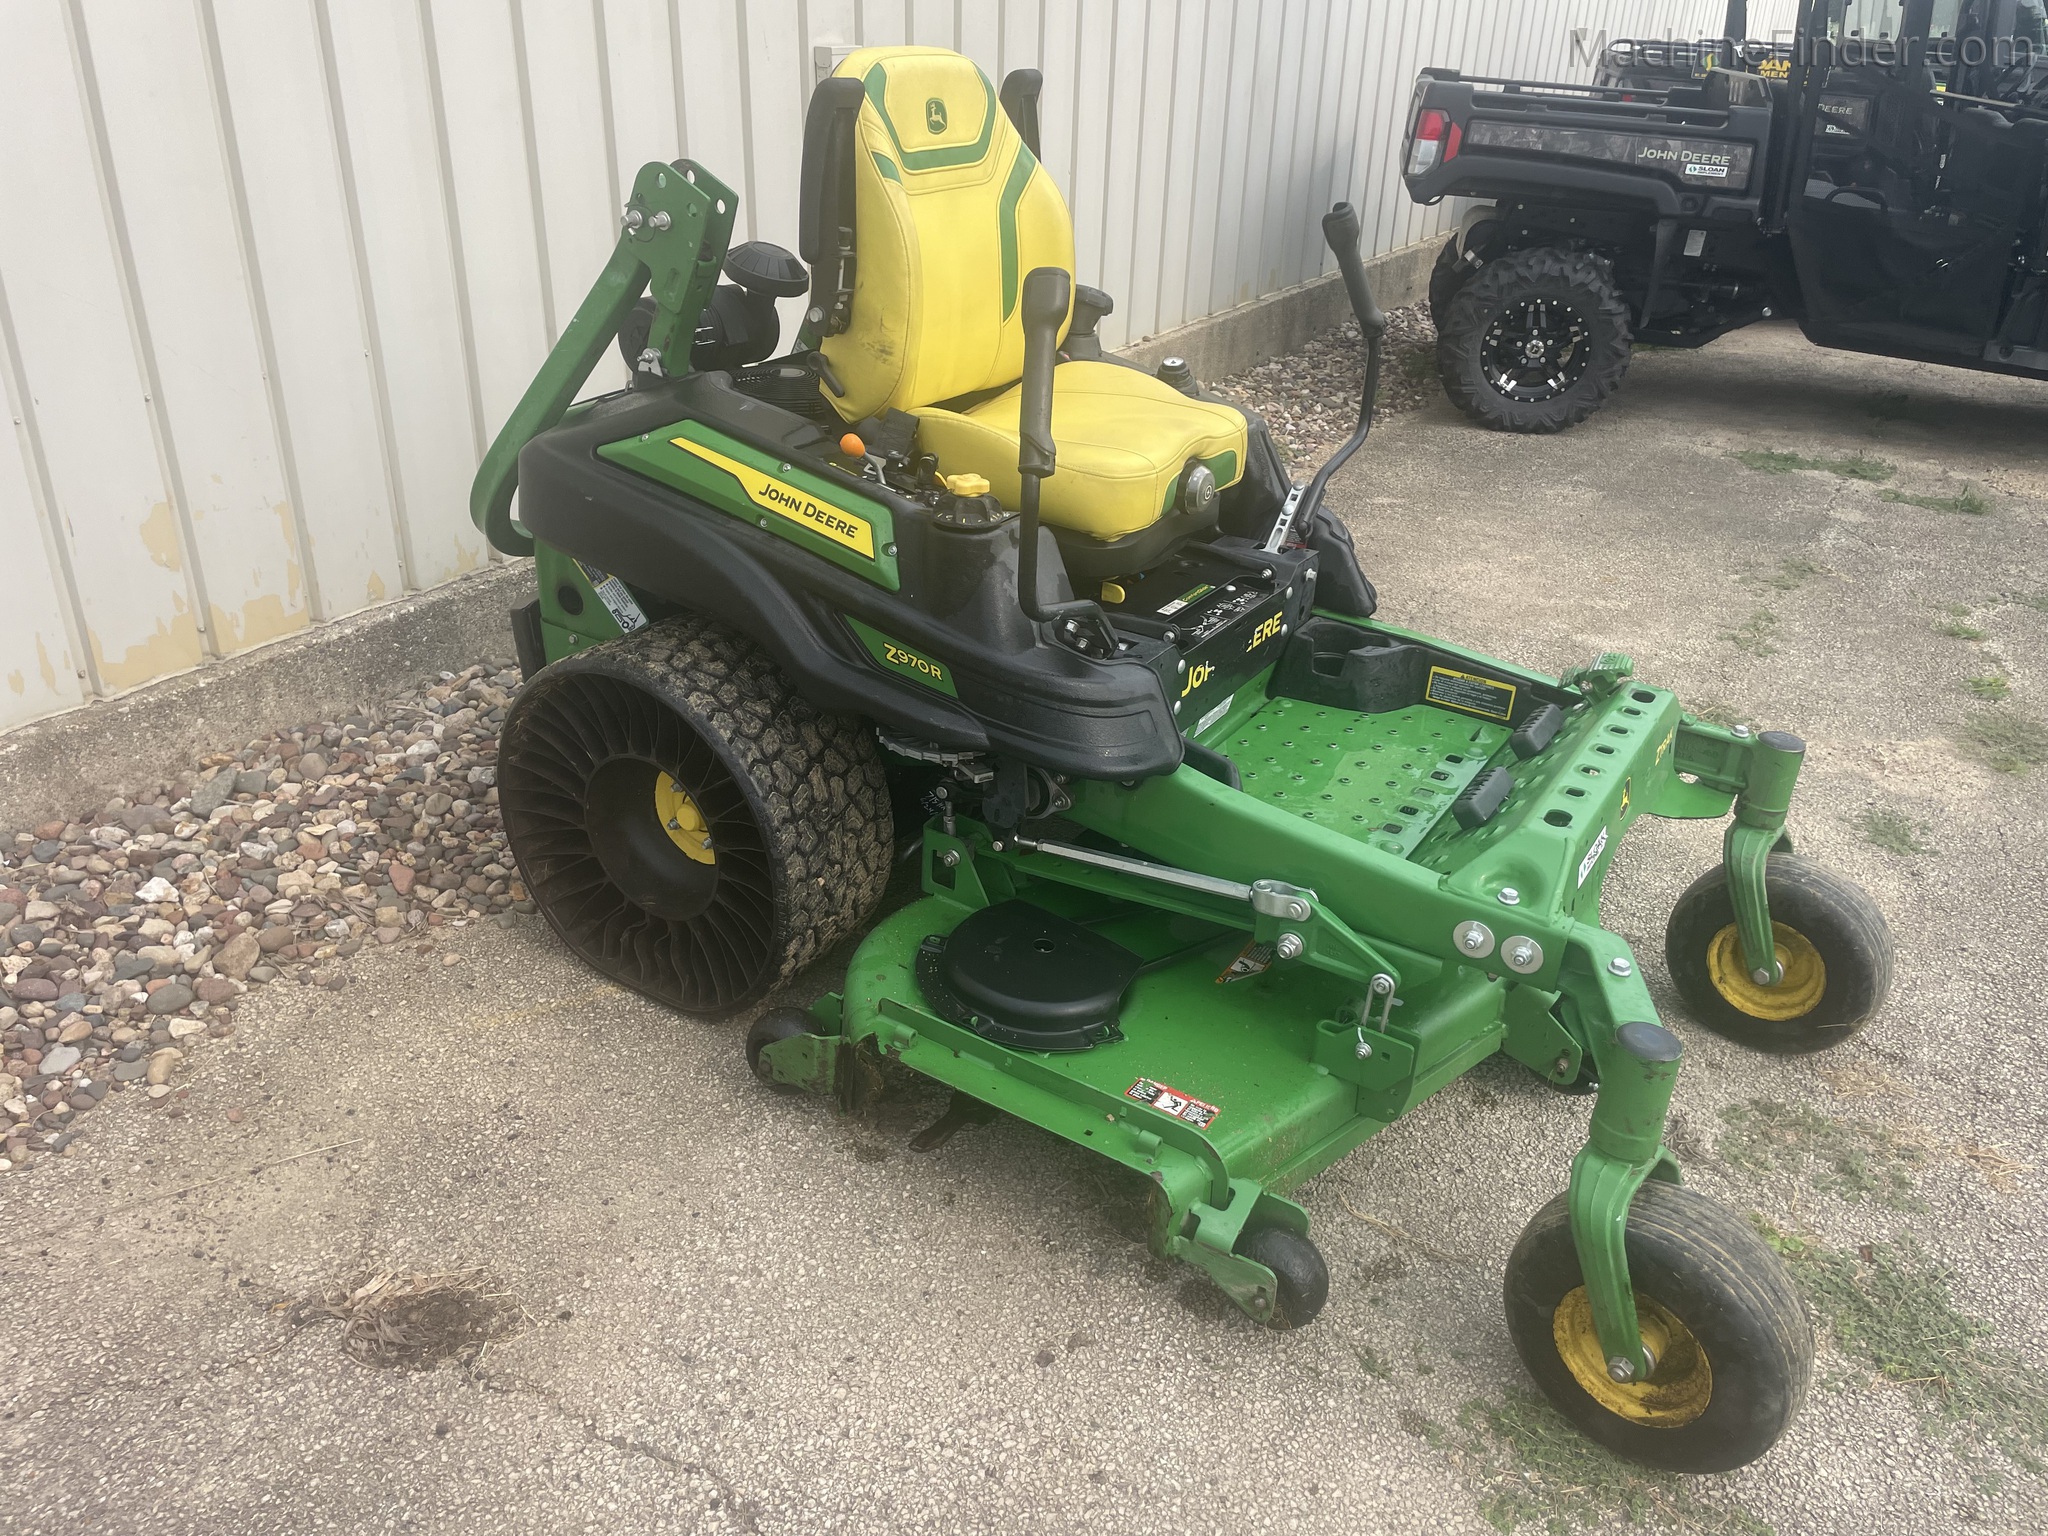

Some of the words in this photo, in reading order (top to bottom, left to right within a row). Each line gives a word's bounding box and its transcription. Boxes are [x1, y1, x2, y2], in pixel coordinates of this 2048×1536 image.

[1638, 146, 1678, 161] JOHN
[1681, 150, 1731, 166] DEERE
[758, 483, 802, 512] JOHN
[802, 502, 858, 539] DEERE
[883, 642, 943, 681] Z970R
